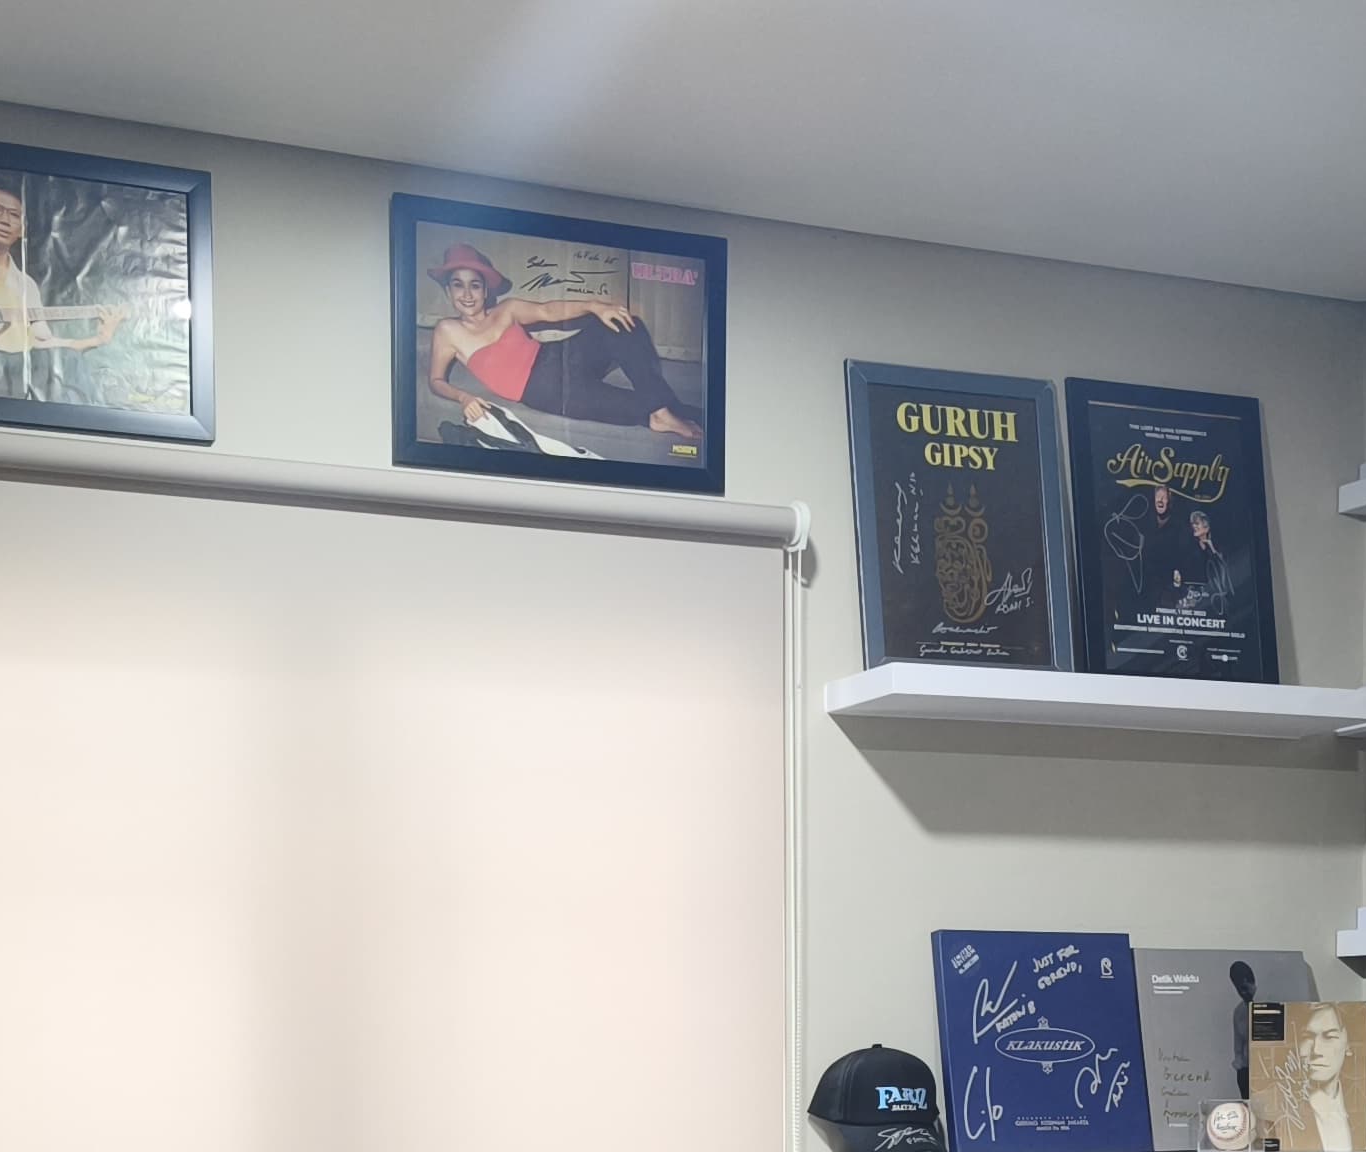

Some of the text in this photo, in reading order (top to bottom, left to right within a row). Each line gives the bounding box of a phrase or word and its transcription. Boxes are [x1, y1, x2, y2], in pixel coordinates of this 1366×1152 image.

[896, 401, 1019, 443] GURUH
[924, 441, 999, 471] GIPSY
[1151, 445, 1231, 493] Supply
[1137, 613, 1226, 630] LIVE IN CONCERT
[1033, 953, 1054, 973] JUST
